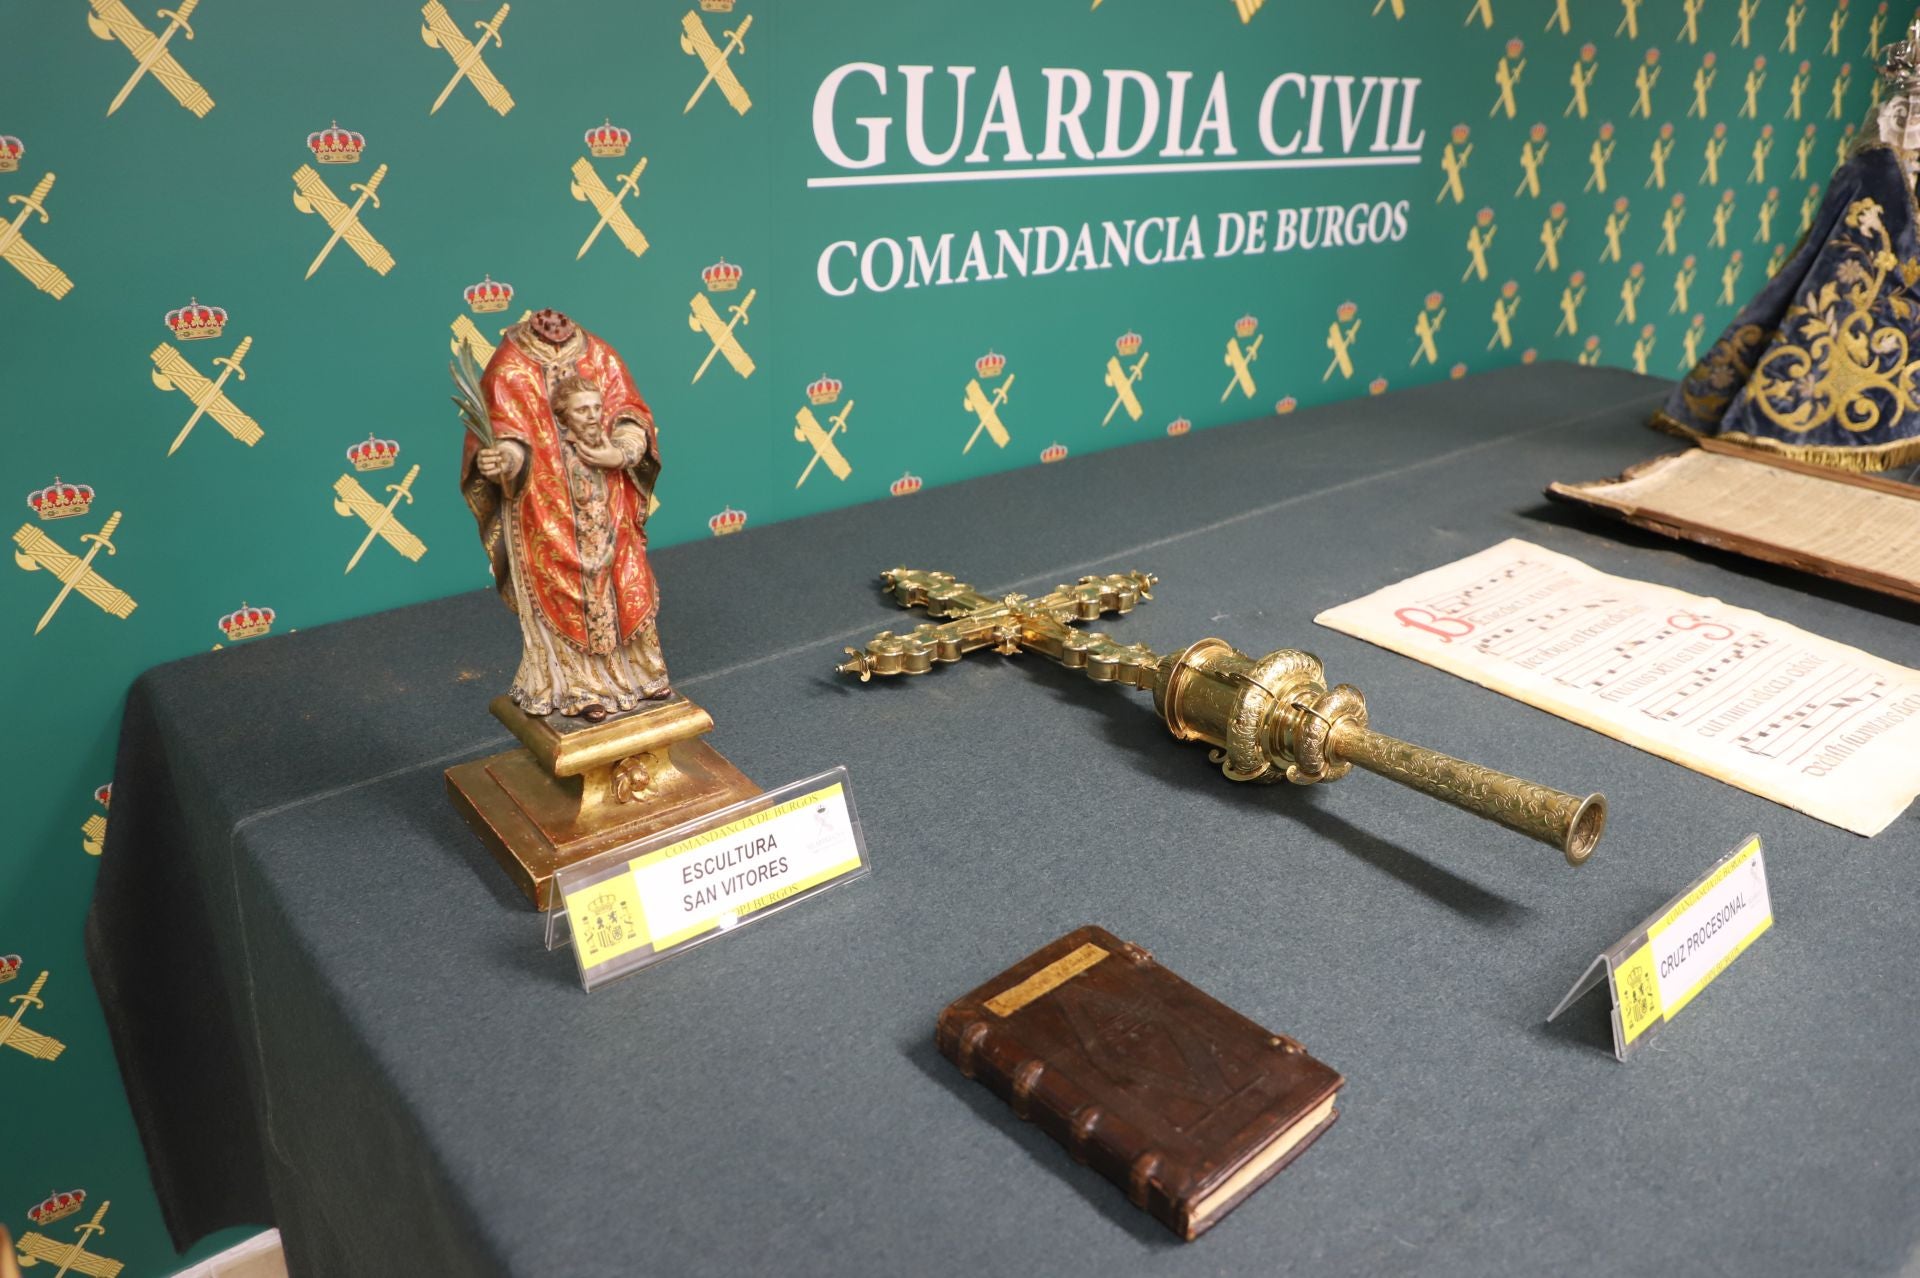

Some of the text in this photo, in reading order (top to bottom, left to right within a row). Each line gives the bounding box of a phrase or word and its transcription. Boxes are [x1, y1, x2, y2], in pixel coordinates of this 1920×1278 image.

[812, 61, 1425, 169] GUARDIA CIVIL
[816, 200, 1409, 297] COMANDANCIA DE BURGOS
[665, 794, 818, 858] COMANDANCIA DE BURGOS
[682, 834, 777, 884] ESCULTURA
[683, 857, 789, 912] SAN VITORES
[1661, 944, 1687, 978] CRUZ
[1687, 891, 1746, 957] PROCESIONAL
